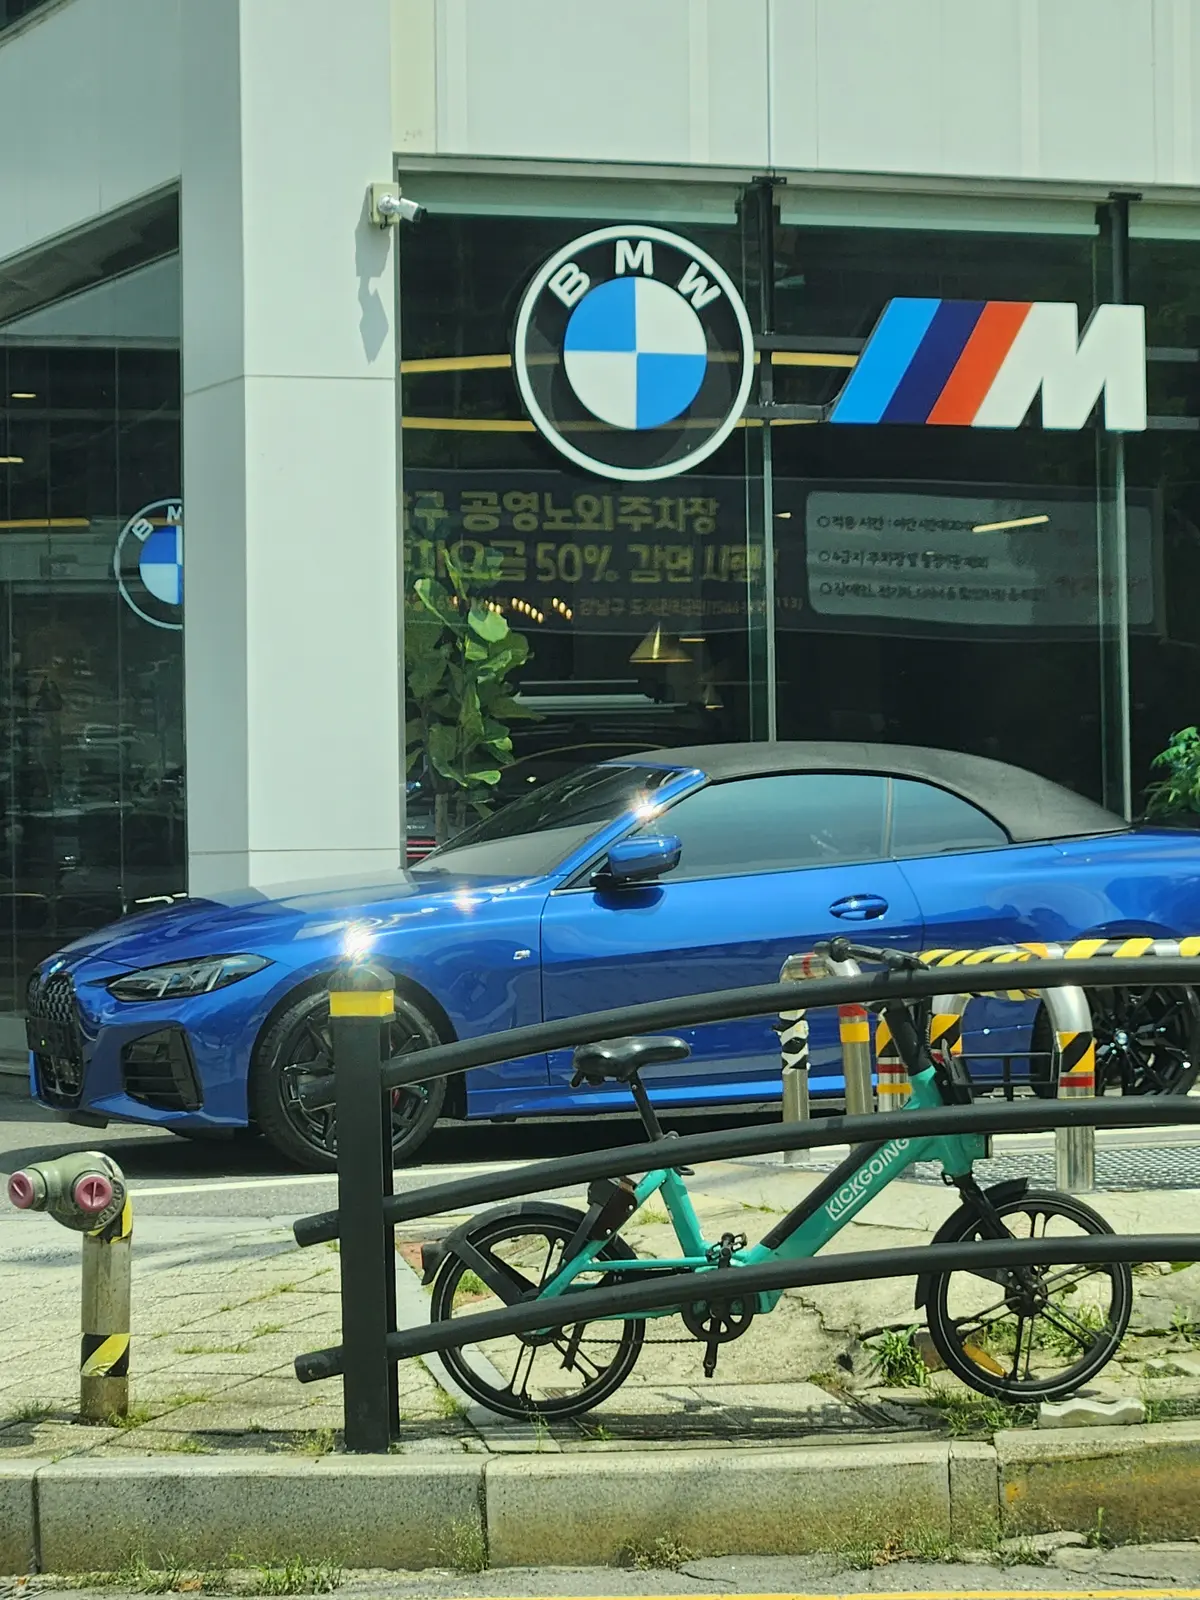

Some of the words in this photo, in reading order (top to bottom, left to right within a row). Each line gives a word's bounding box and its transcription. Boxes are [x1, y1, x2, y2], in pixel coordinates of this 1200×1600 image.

[548, 240, 721, 309] BMW
[131, 505, 183, 542] BM
[536, 542, 620, 583] 50%
[825, 1139, 910, 1220] KICKGOING
